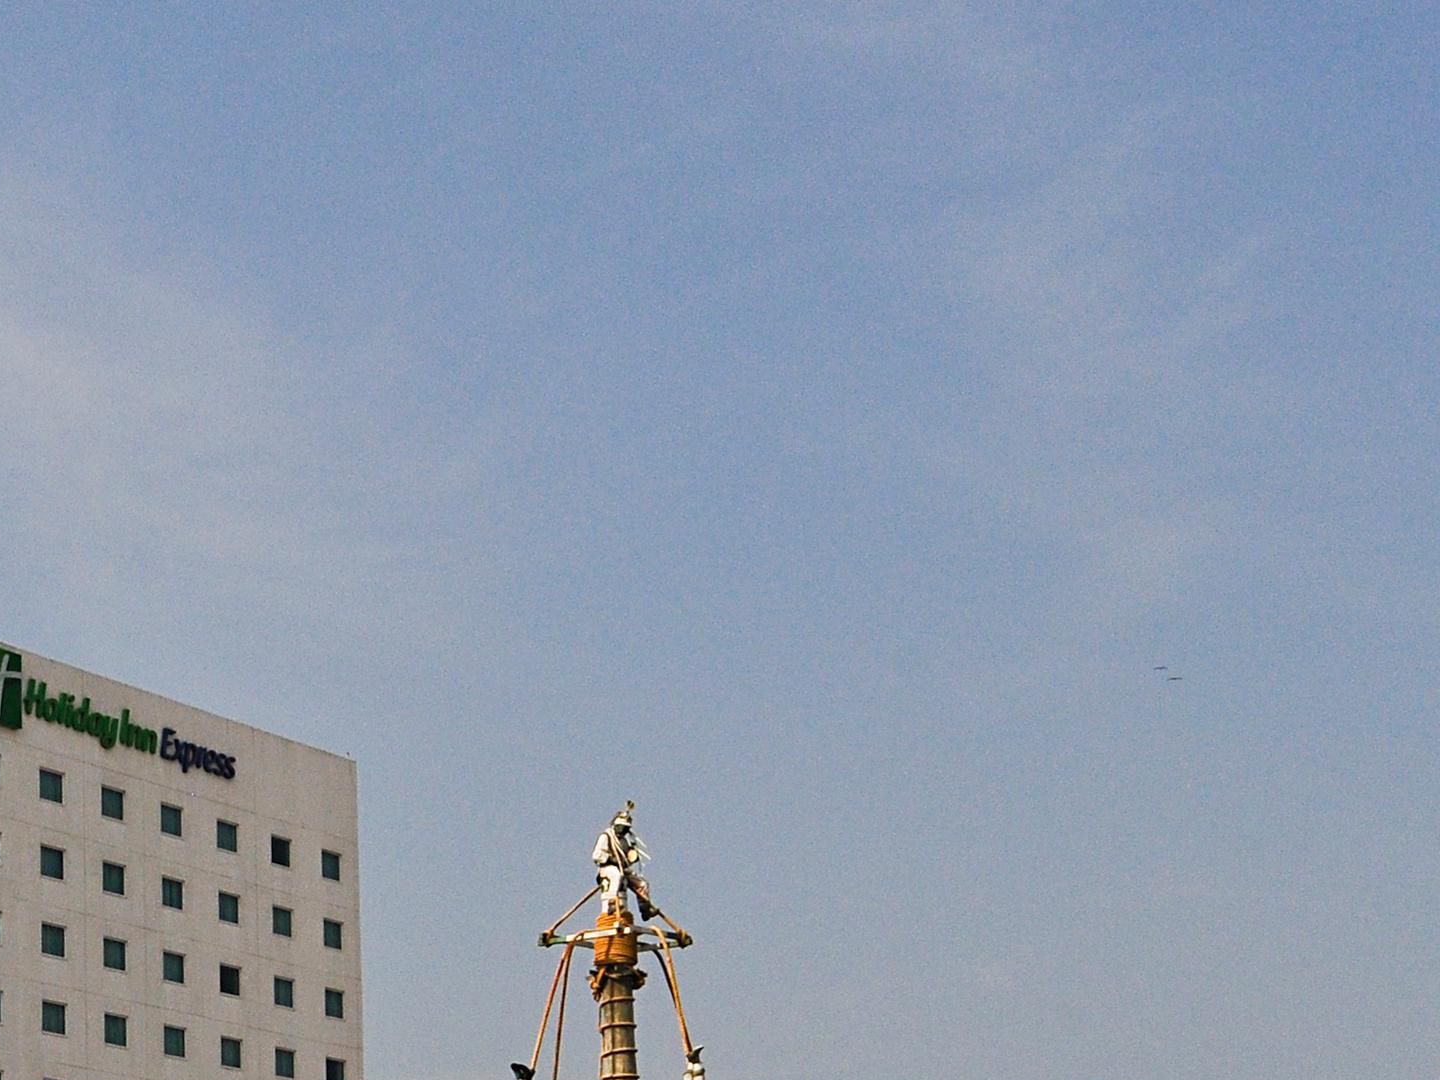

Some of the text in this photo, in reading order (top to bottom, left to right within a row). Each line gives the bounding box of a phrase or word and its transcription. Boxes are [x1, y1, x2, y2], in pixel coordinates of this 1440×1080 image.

[23, 678, 237, 780] Holiday Inn Express
